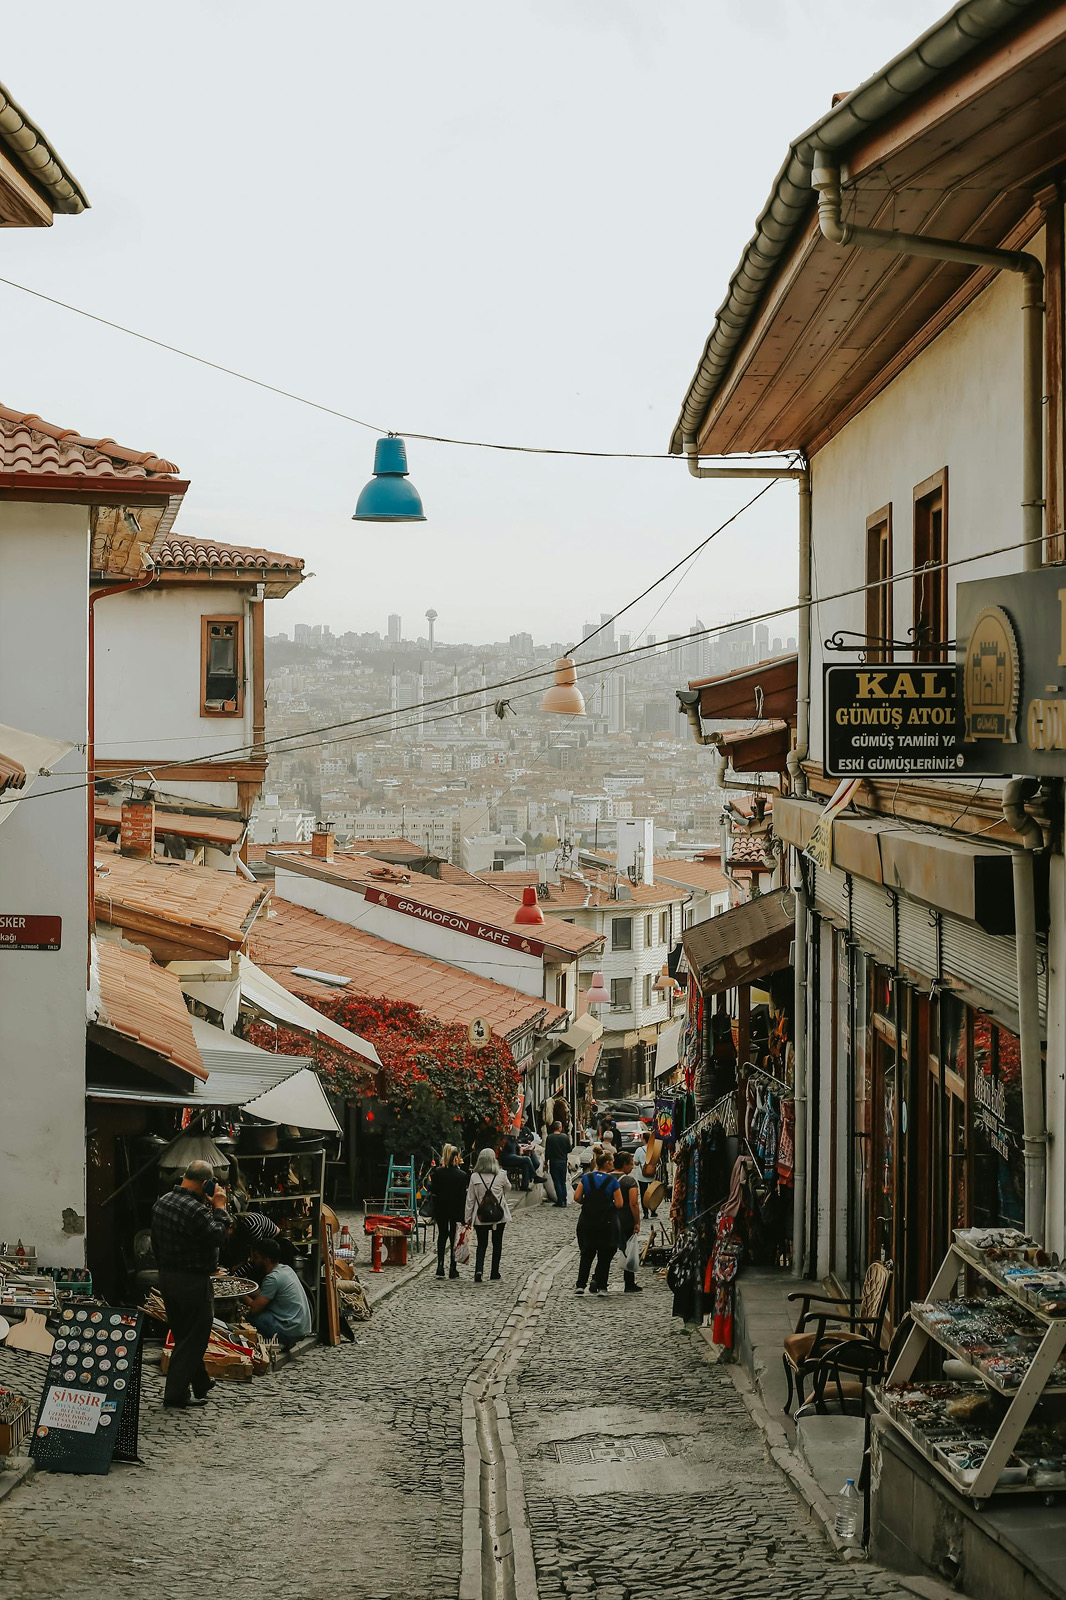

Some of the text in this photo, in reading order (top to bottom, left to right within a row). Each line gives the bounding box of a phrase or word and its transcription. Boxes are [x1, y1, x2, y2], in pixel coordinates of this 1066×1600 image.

[835, 702, 956, 730] GÜMÜŞ ATOL
[977, 715, 998, 734] GÜMÜŞ
[851, 733, 895, 750] GÜMÜŞ
[897, 733, 939, 747] TAMİRİ
[838, 756, 864, 769] ESKİ
[867, 756, 956, 773] GÜMÜŞLERİNİZ
[0, 917, 26, 928] SKER
[397, 901, 511, 945] GRAMOFON KAFE
[53, 1389, 101, 1407] ŞİMŞİR
